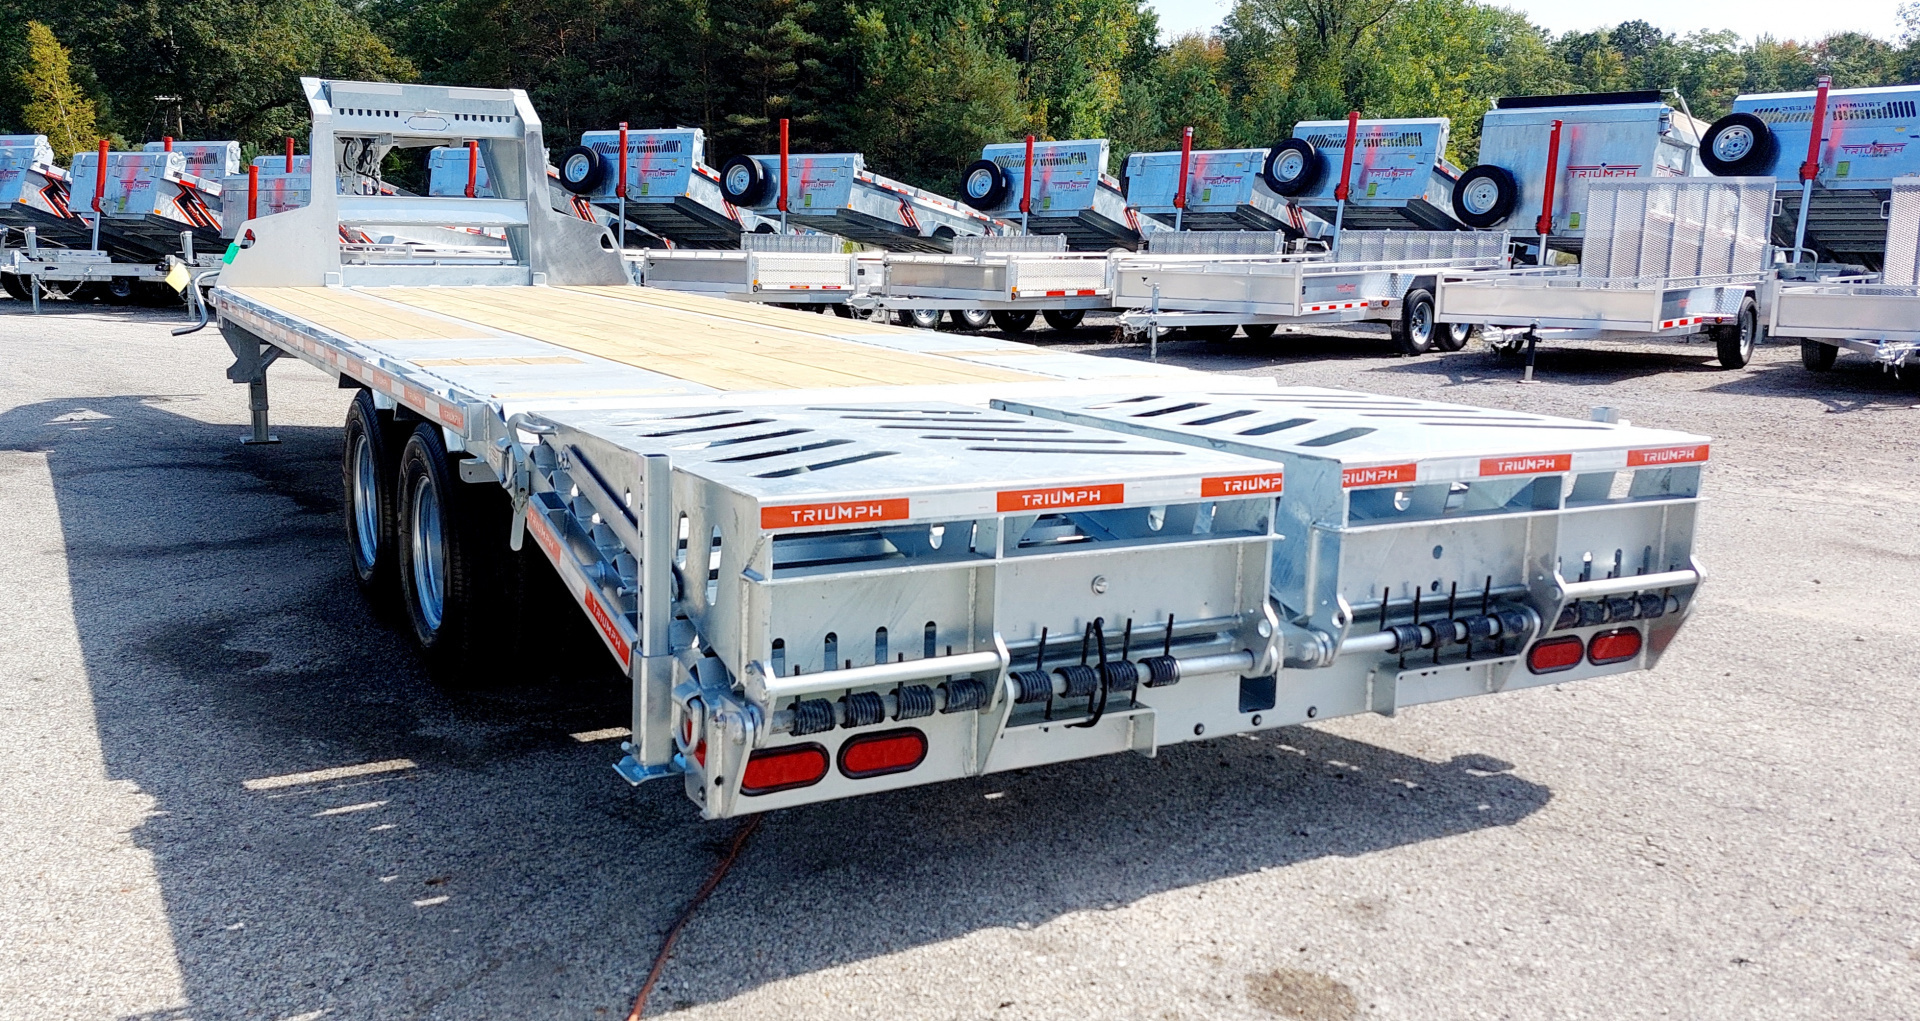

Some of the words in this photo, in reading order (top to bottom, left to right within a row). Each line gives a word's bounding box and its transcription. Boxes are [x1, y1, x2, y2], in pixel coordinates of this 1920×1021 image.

[1843, 146, 1904, 155] TRIUMPH
[1370, 170, 1413, 178] TRIUMPH
[1570, 169, 1637, 179] TRIUMPH
[1643, 449, 1695, 462] TRIUMPH
[1498, 458, 1556, 472] TRIUMPH
[1021, 490, 1101, 507] TRIUMPH
[790, 504, 883, 523] TRIUMPH
[529, 511, 555, 551] TRIUMPH
[592, 601, 622, 651] TRIUMPH
